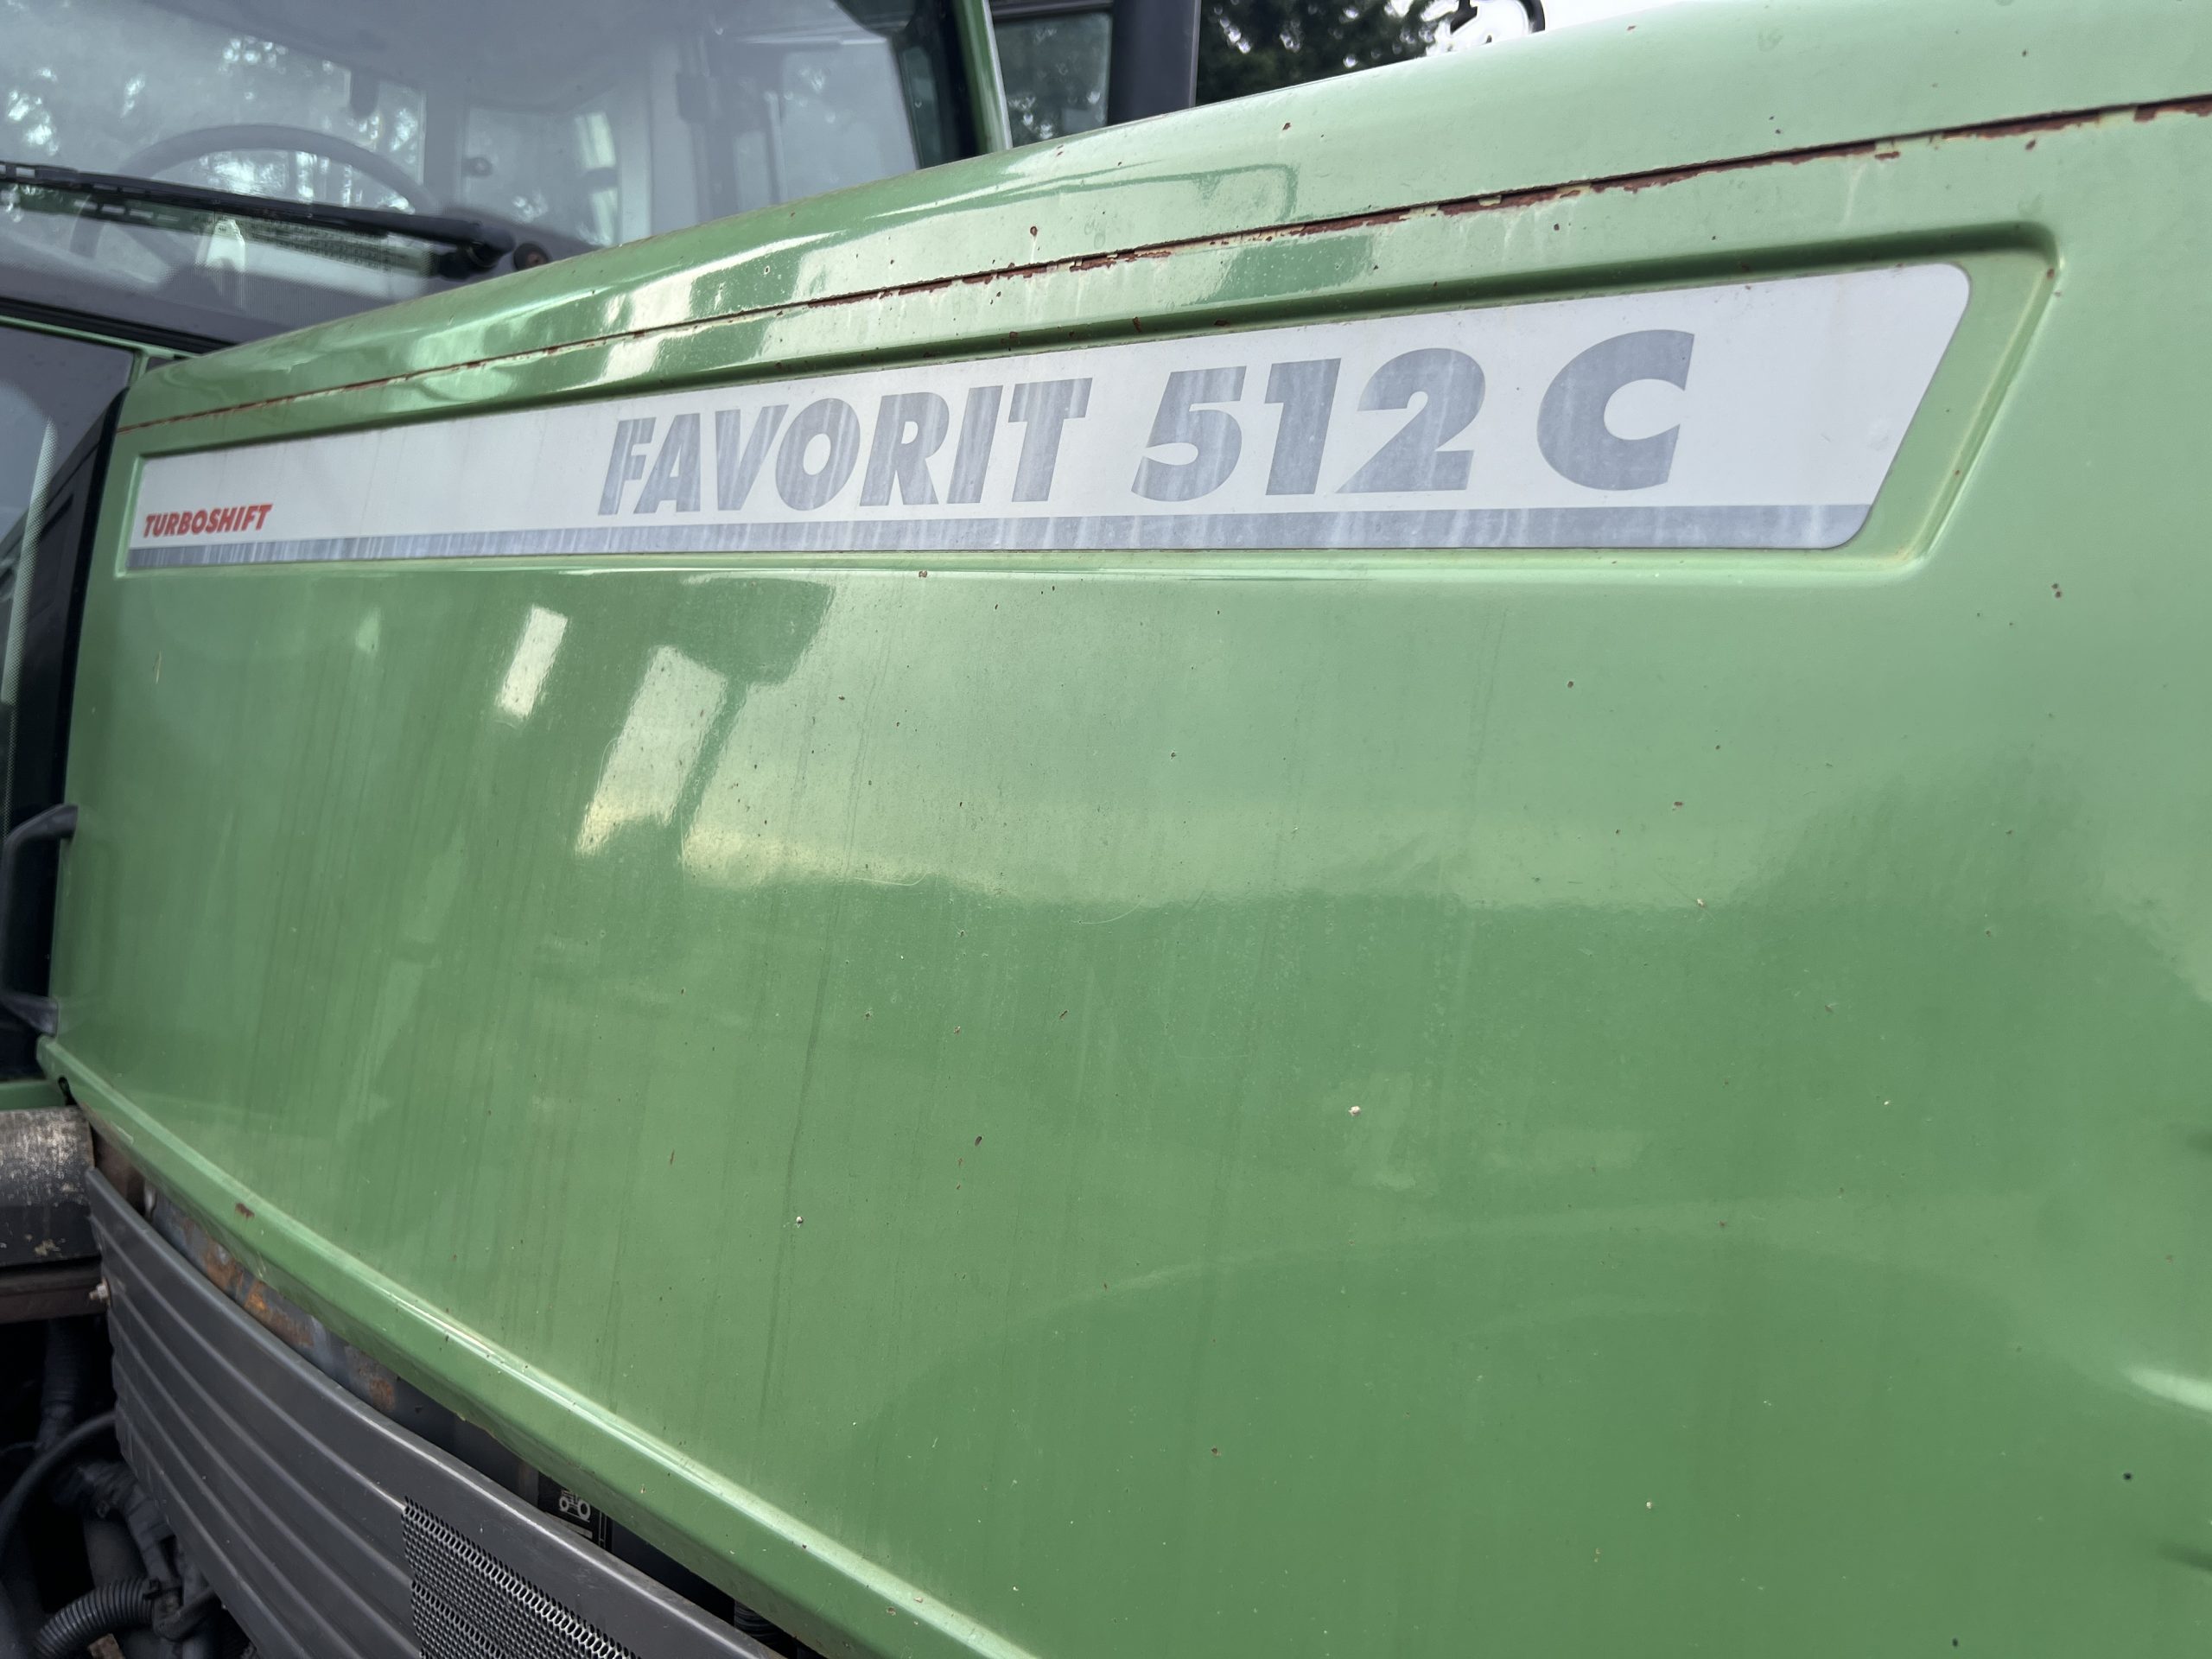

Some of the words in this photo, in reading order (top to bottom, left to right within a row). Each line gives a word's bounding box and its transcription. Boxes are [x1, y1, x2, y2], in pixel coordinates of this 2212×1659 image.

[598, 378, 1093, 515] FAVORIT
[1131, 347, 1486, 502] 512
[1536, 329, 1695, 491] C
[143, 503, 273, 538] TURBOSHIFT
